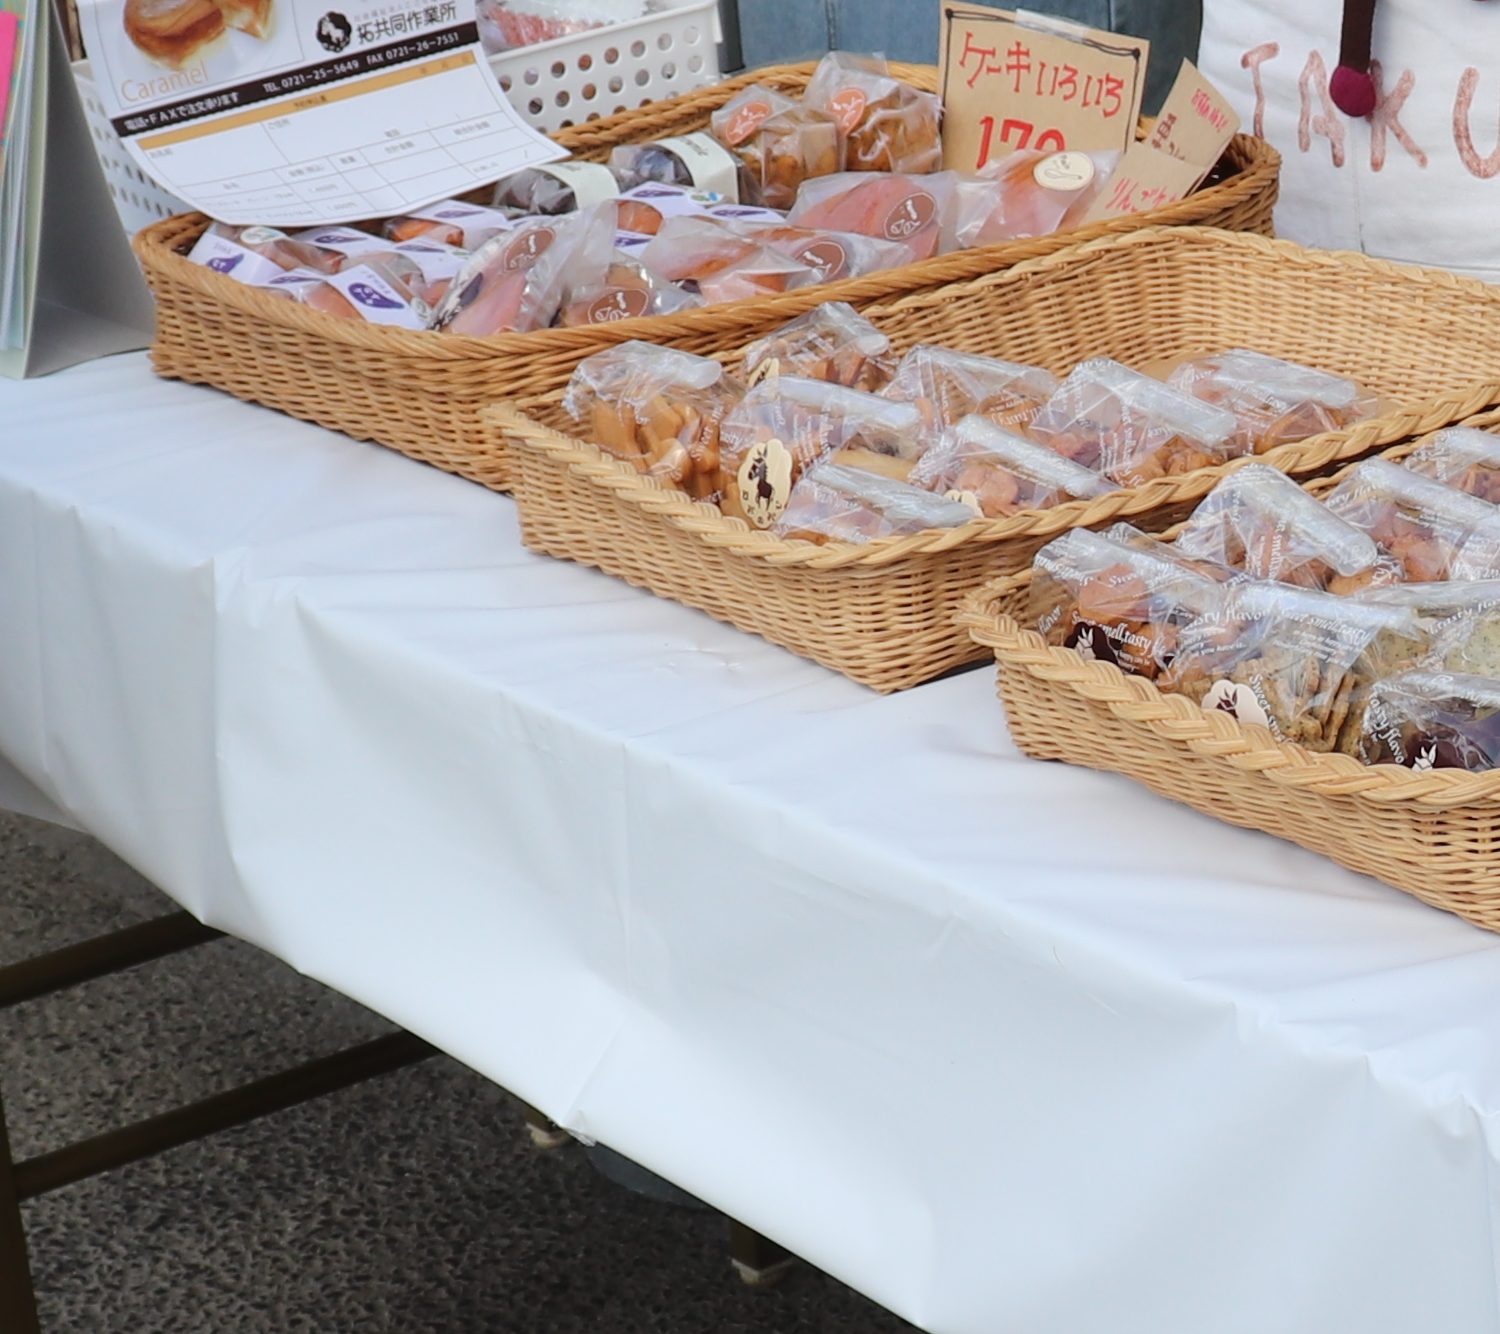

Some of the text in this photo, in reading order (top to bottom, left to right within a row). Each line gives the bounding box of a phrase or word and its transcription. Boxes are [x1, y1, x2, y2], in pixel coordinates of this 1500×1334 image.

[357, 1, 457, 46] 拓共同作業所
[120, 59, 210, 105] Caramel
[958, 31, 1125, 118] ケーキいろいろ
